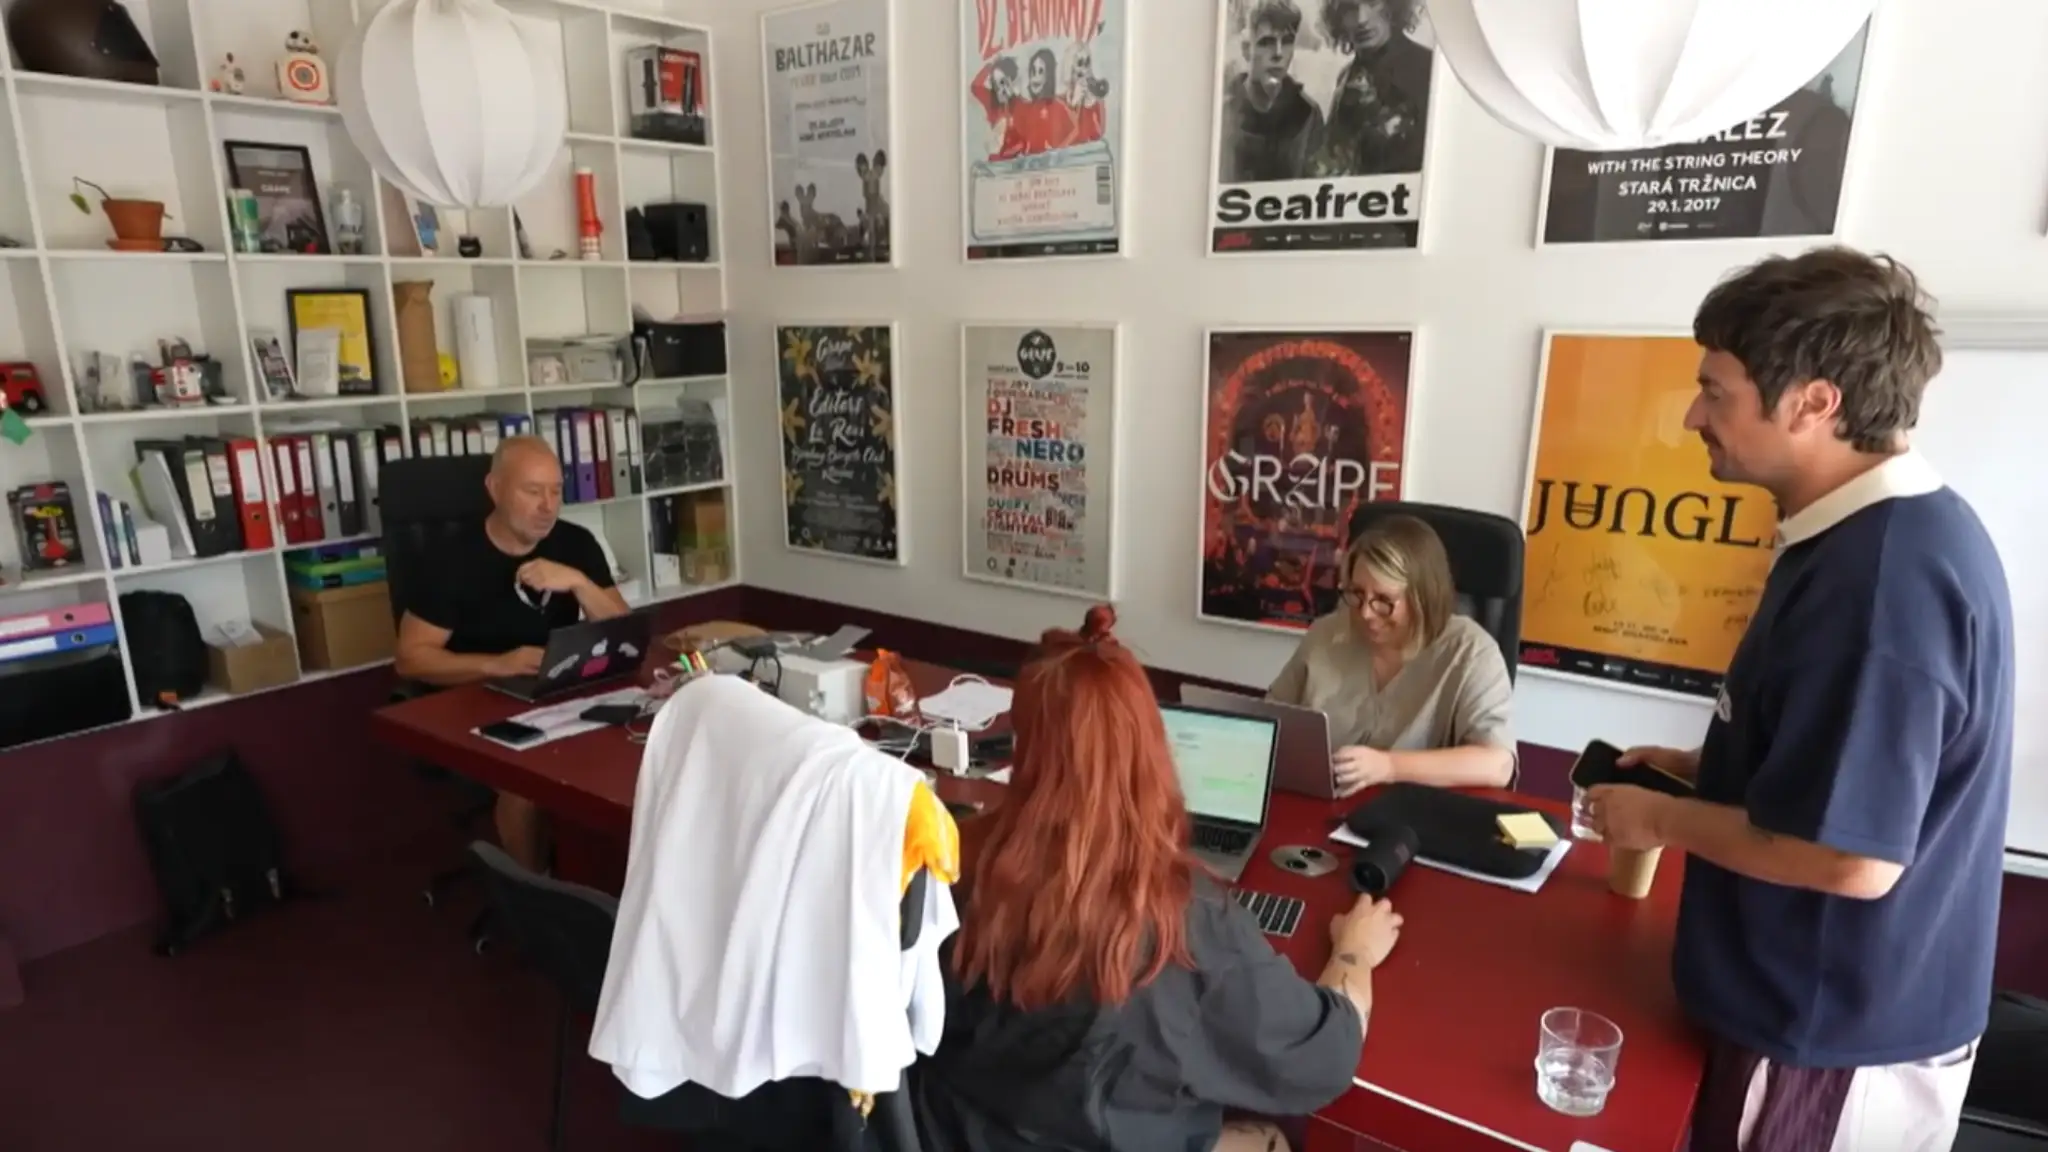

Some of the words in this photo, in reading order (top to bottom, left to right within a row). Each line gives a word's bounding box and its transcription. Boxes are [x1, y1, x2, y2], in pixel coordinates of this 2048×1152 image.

[776, 32, 875, 72] BALTHAZAR
[1588, 160, 1627, 176] WITH
[1631, 157, 1662, 173] THE
[1664, 153, 1727, 171] STRING
[1731, 148, 1803, 167] THEORY
[1618, 176, 1674, 197] STARÁ
[1678, 173, 1758, 193] TRŽNICA
[1216, 183, 1411, 224] Seafret
[987, 397, 1012, 417] DJ
[987, 416, 1061, 440] FRESH
[1015, 438, 1086, 463] NERO
[987, 465, 1061, 492] DRUMS
[1526, 479, 1775, 550] JUNGL
